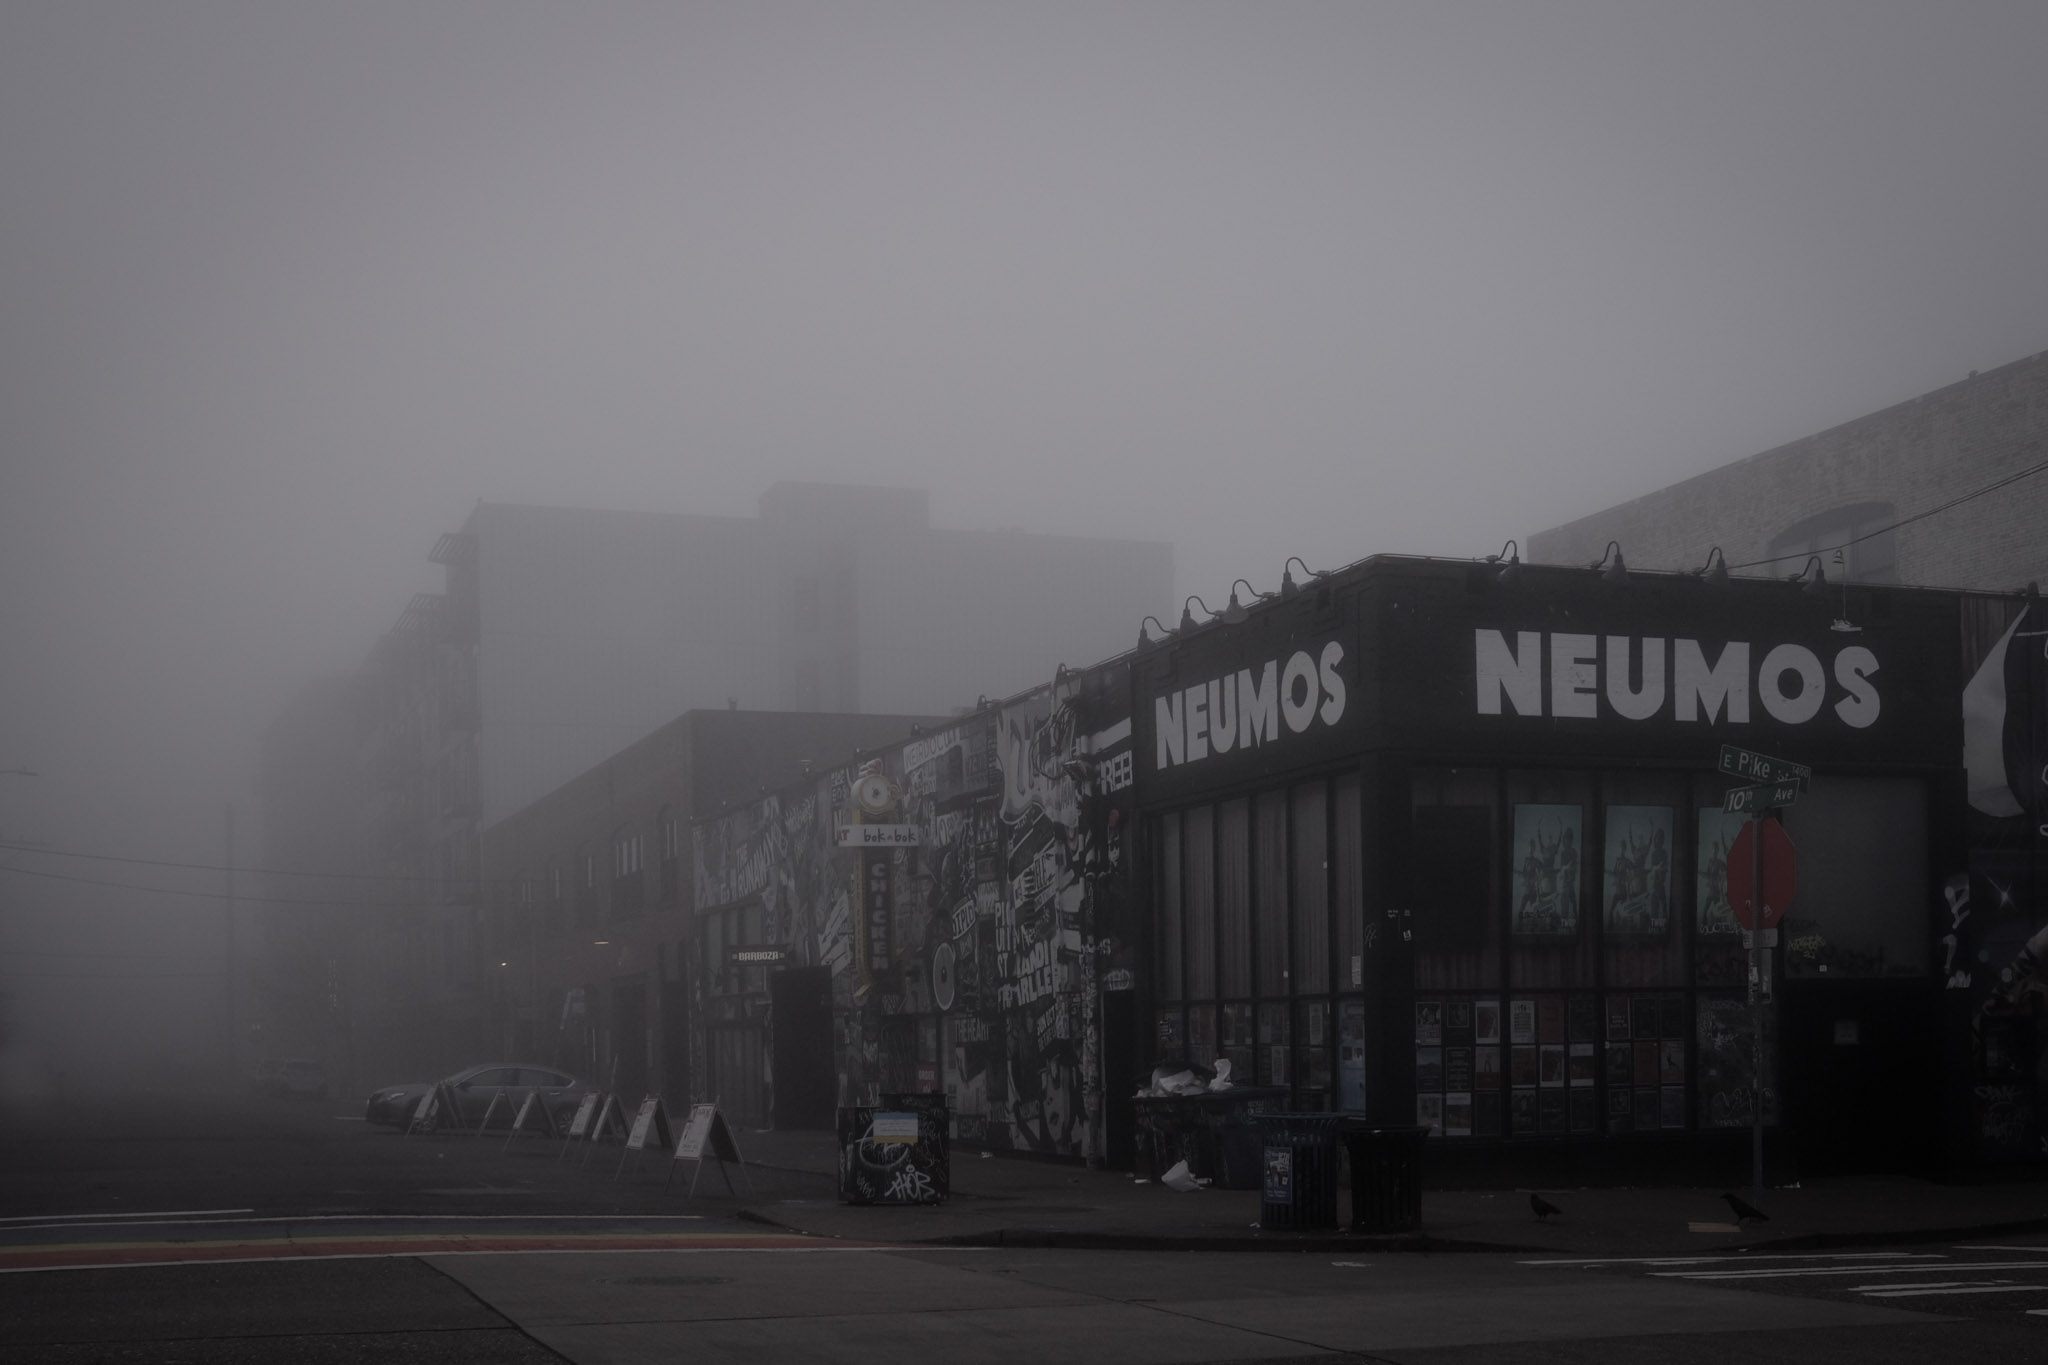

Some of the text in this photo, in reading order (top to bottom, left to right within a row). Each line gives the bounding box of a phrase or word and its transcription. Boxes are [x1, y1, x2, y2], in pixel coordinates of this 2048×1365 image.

[1474, 627, 1881, 729] NEUMOS
[1155, 640, 1346, 770] NEUMOS
[1723, 753, 1732, 769] E
[1738, 752, 1771, 778] Pike
[1728, 788, 1794, 812] 10th Ave
[864, 828, 886, 843] bok
[894, 828, 917, 843] bok
[869, 862, 889, 971] CHICKEN
[738, 951, 779, 961] BARBOZA
[918, 1069, 935, 1081] ORDER
